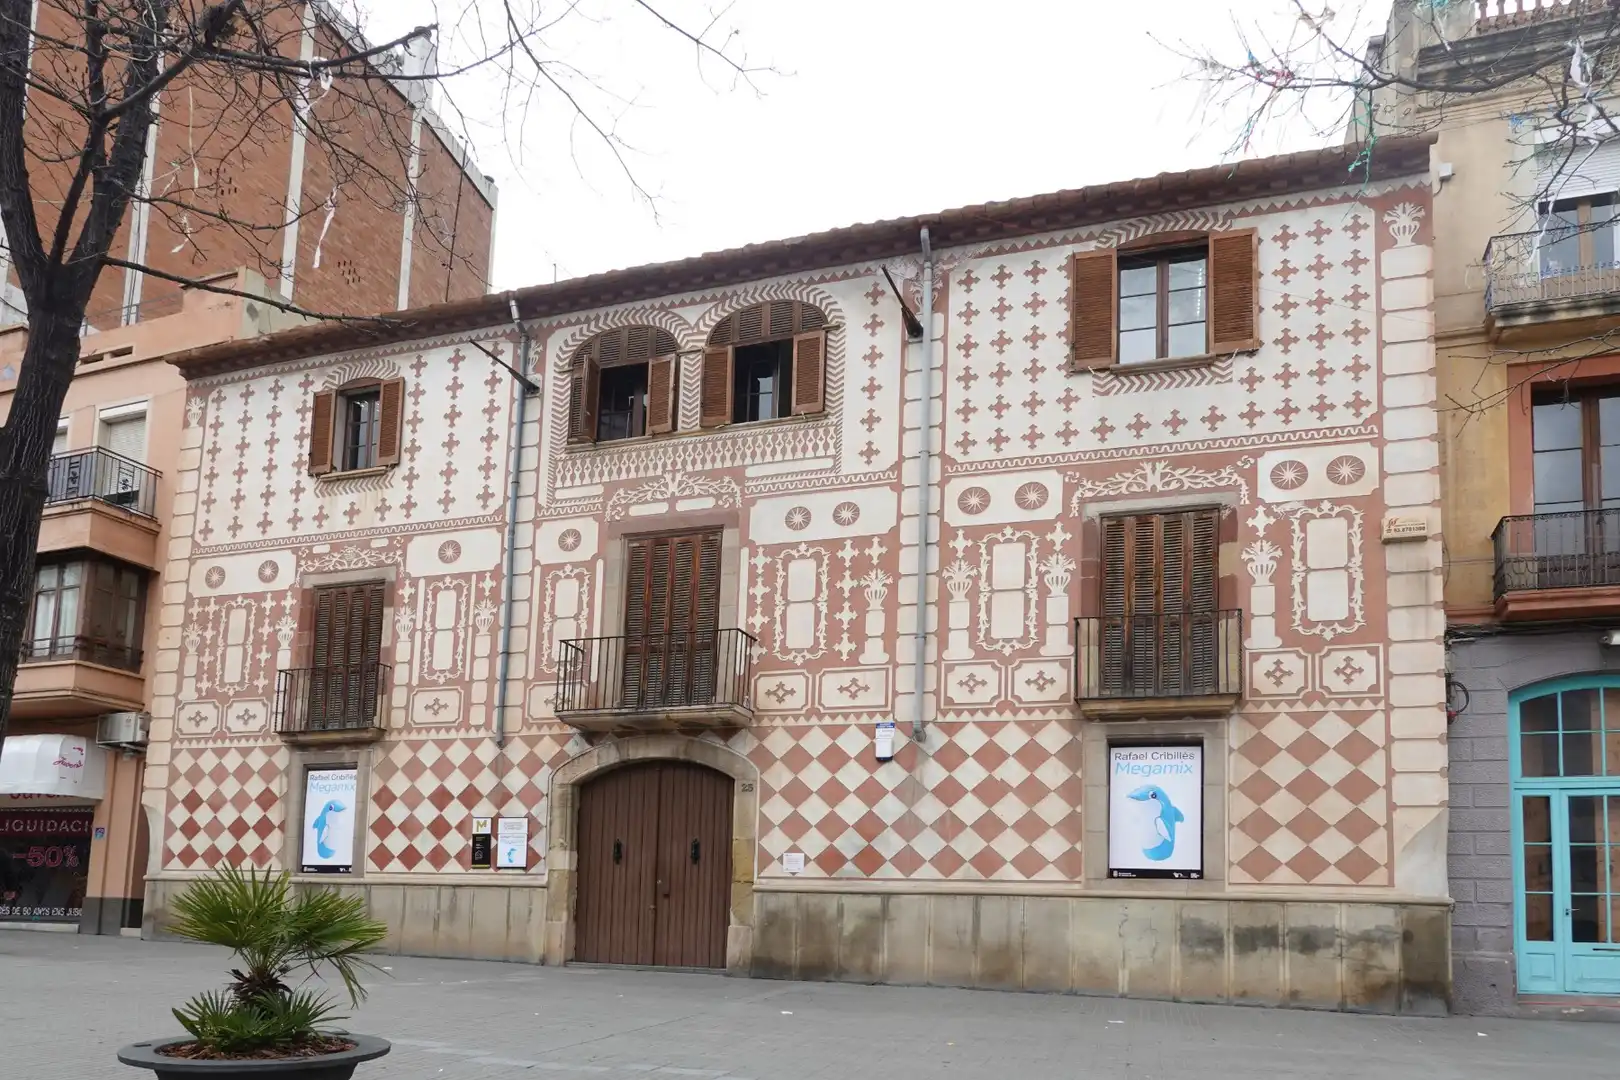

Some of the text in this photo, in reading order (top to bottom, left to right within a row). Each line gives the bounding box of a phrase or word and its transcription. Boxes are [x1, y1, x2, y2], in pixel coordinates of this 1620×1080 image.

[1114, 751, 1148, 761] Rafael
[1115, 760, 1194, 778] Megamix
[309, 781, 356, 795] Megamix
[741, 783, 754, 793] 25
[12, 845, 80, 868] -50%
[12, 906, 21, 916] DE
[33, 907, 51, 916] ANYS
[51, 907, 66, 917] ENS
